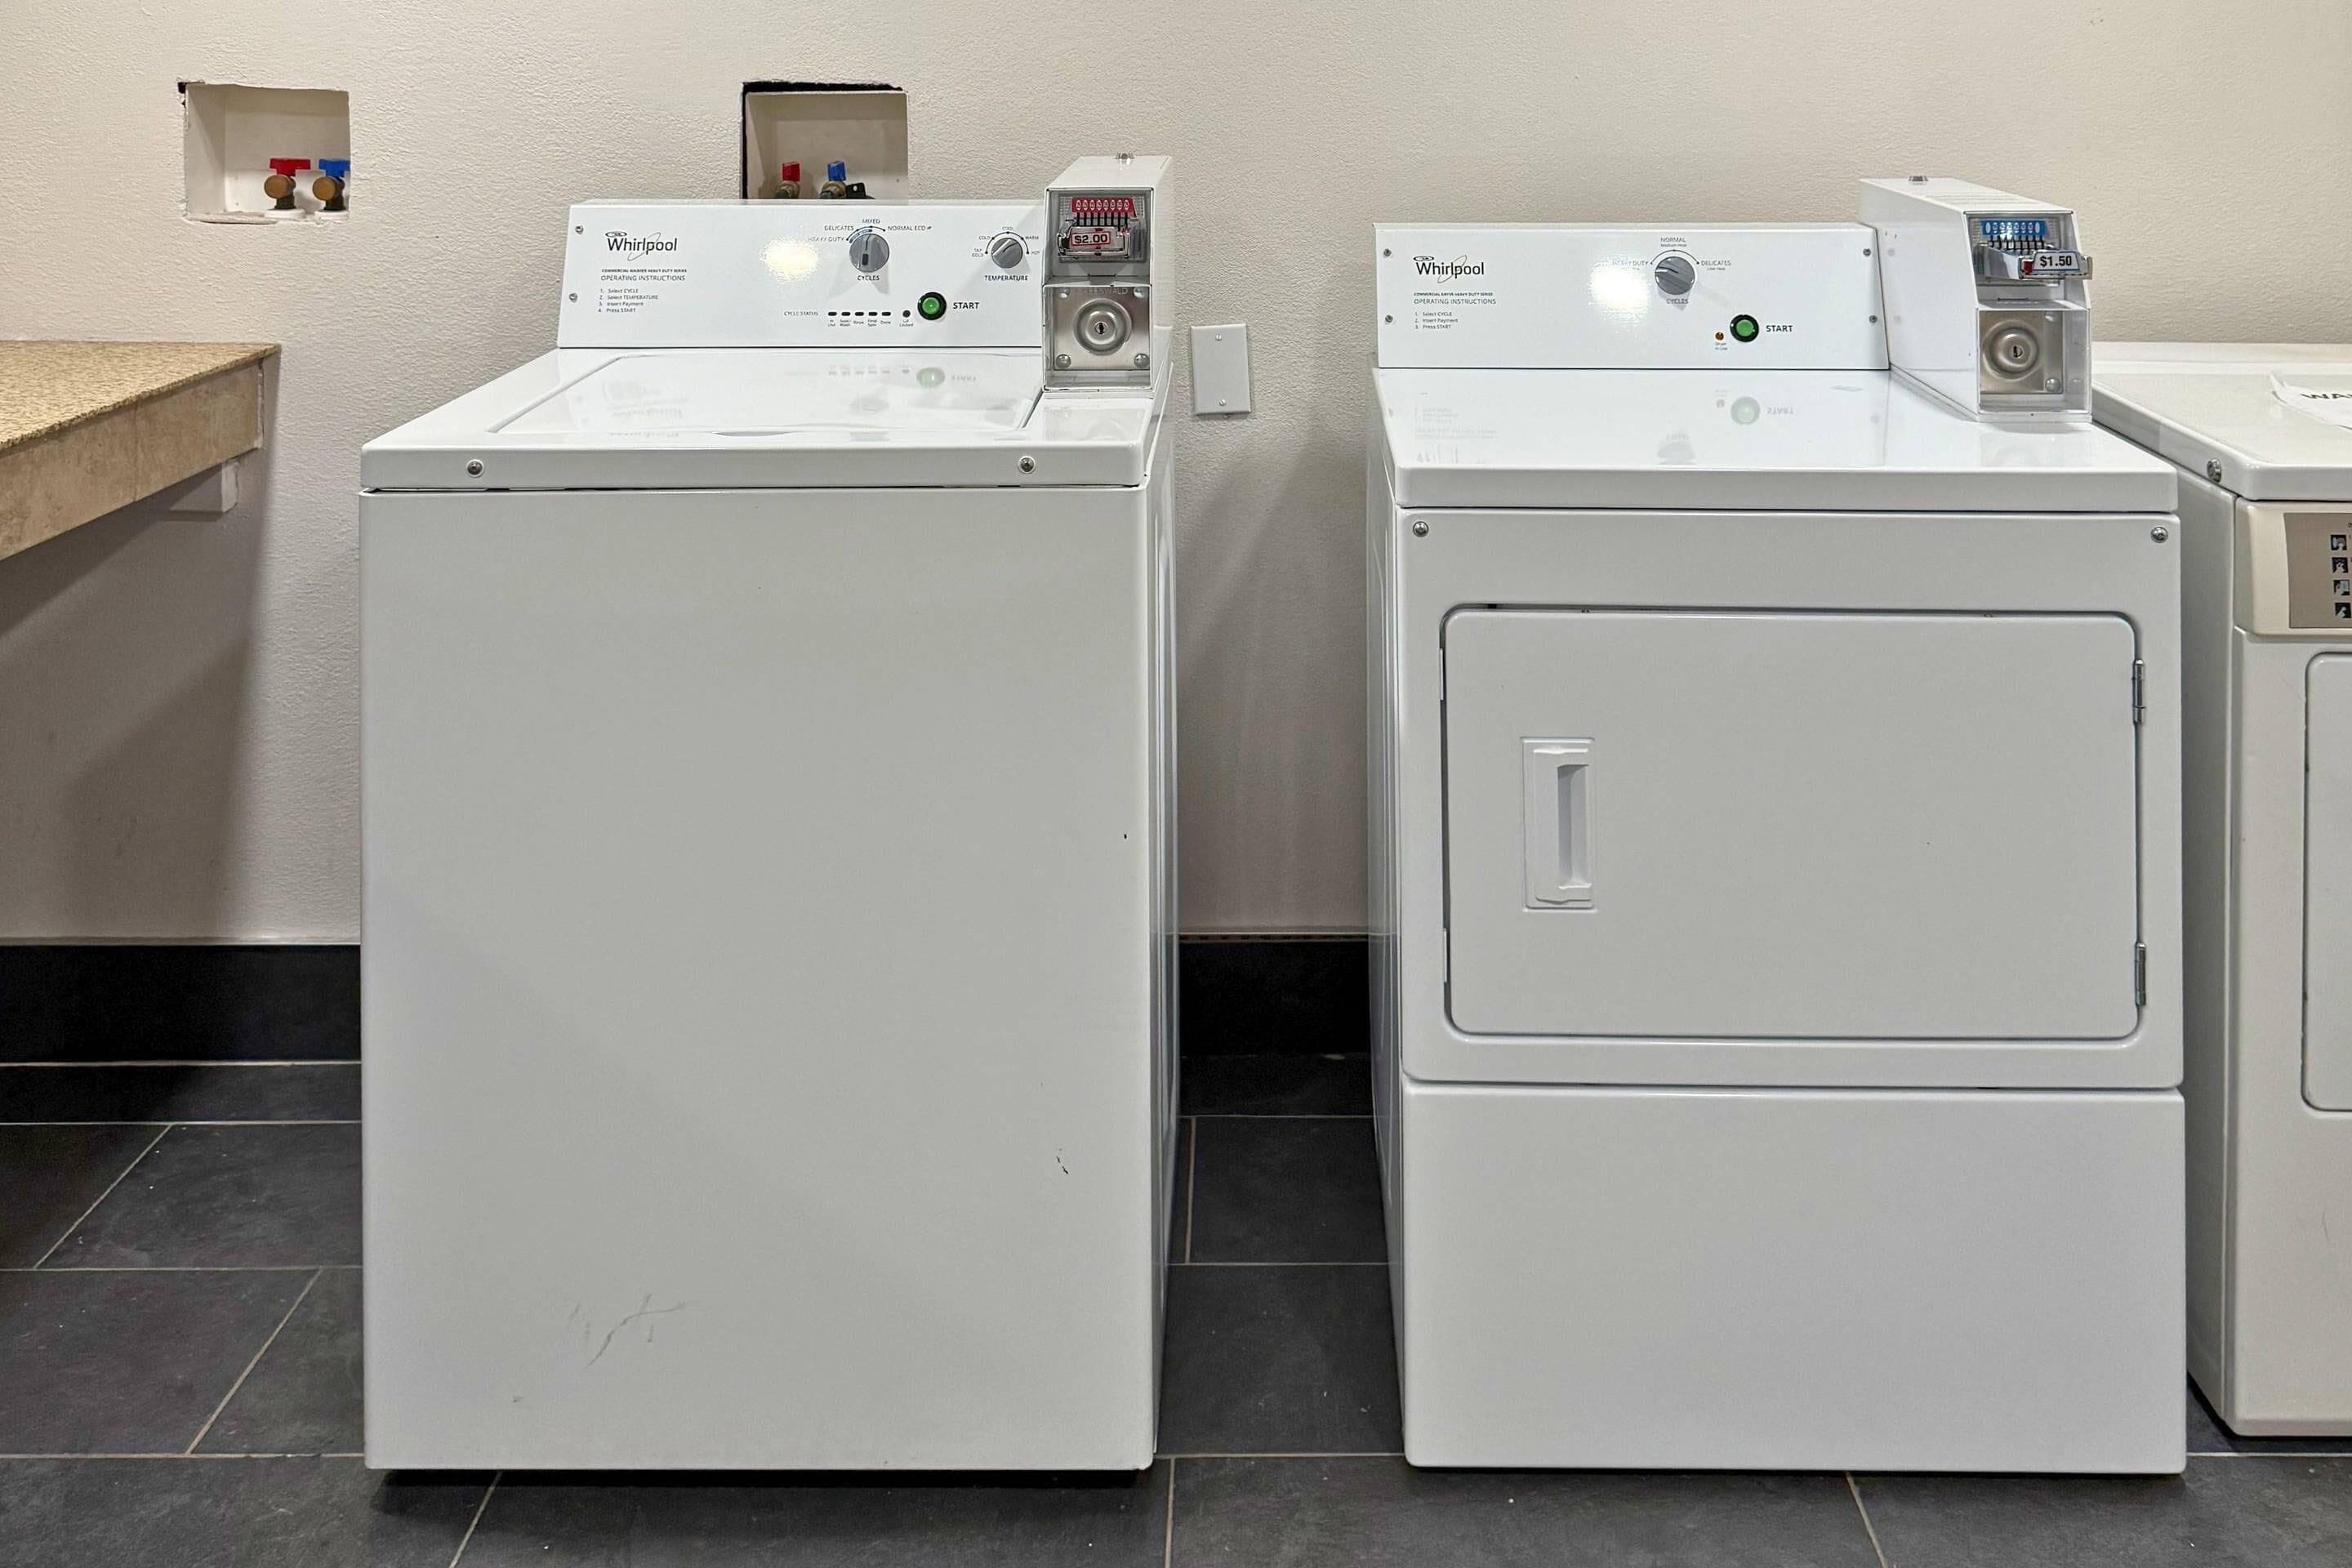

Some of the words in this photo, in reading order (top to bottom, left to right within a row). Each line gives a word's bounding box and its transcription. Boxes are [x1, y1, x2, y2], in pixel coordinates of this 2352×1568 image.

[1074, 234, 1108, 244] $2.00
[607, 237, 678, 256] Whirlpool
[2040, 255, 2072, 268] $1.50
[1415, 261, 1485, 279] Whirlpool
[953, 301, 980, 310] START
[1766, 324, 1793, 332] START
